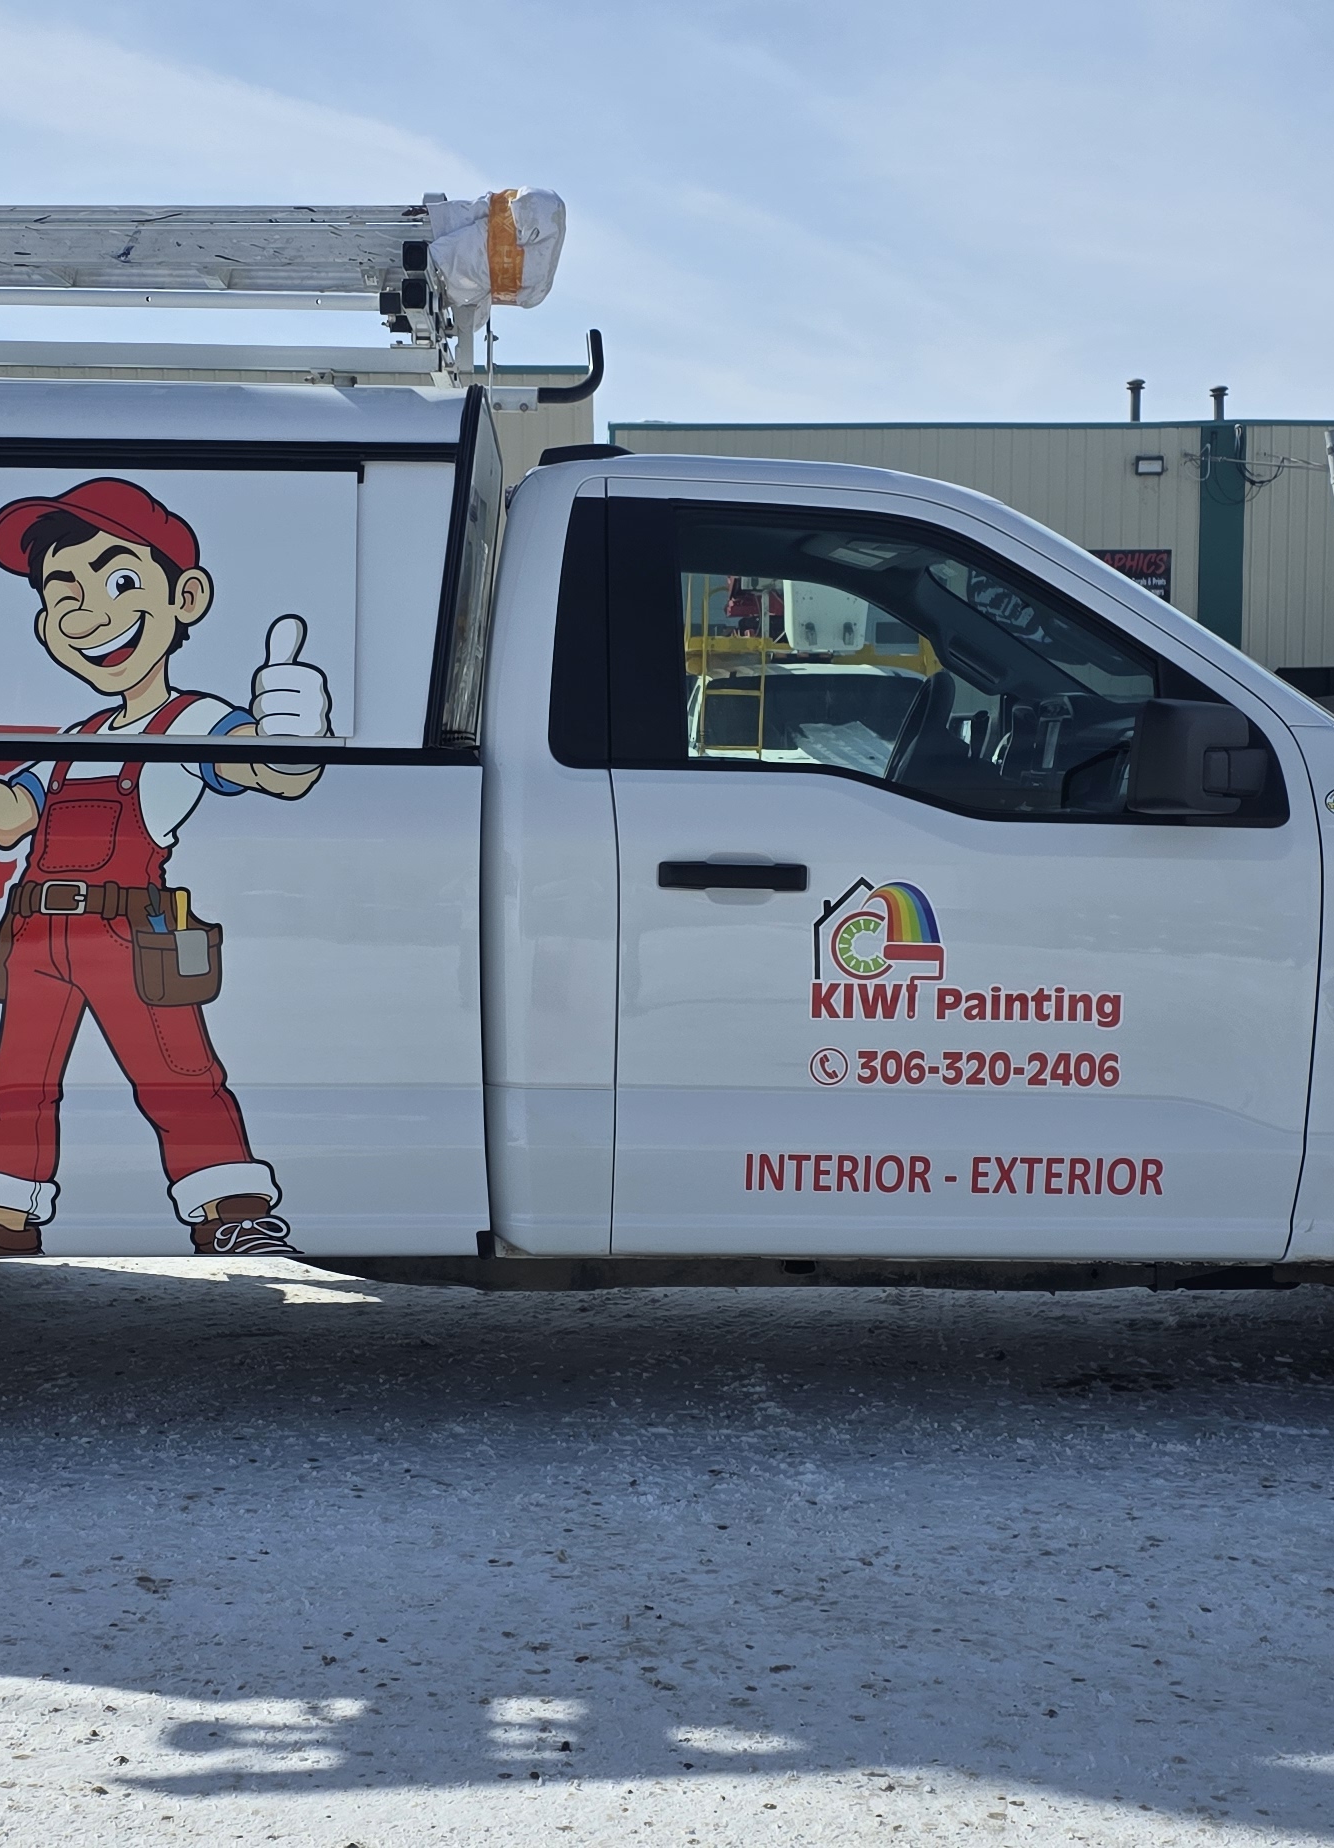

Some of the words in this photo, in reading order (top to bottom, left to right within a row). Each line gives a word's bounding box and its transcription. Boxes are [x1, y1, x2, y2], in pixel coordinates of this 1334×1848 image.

[1097, 552, 1168, 574] APHICS
[936, 986, 1123, 1028] Painting
[856, 1050, 1120, 1088] 306-320-2406
[744, 1153, 932, 1193] INTERIOR
[945, 1175, 957, 1183] -
[970, 1156, 1164, 1196] EXTERIOR
